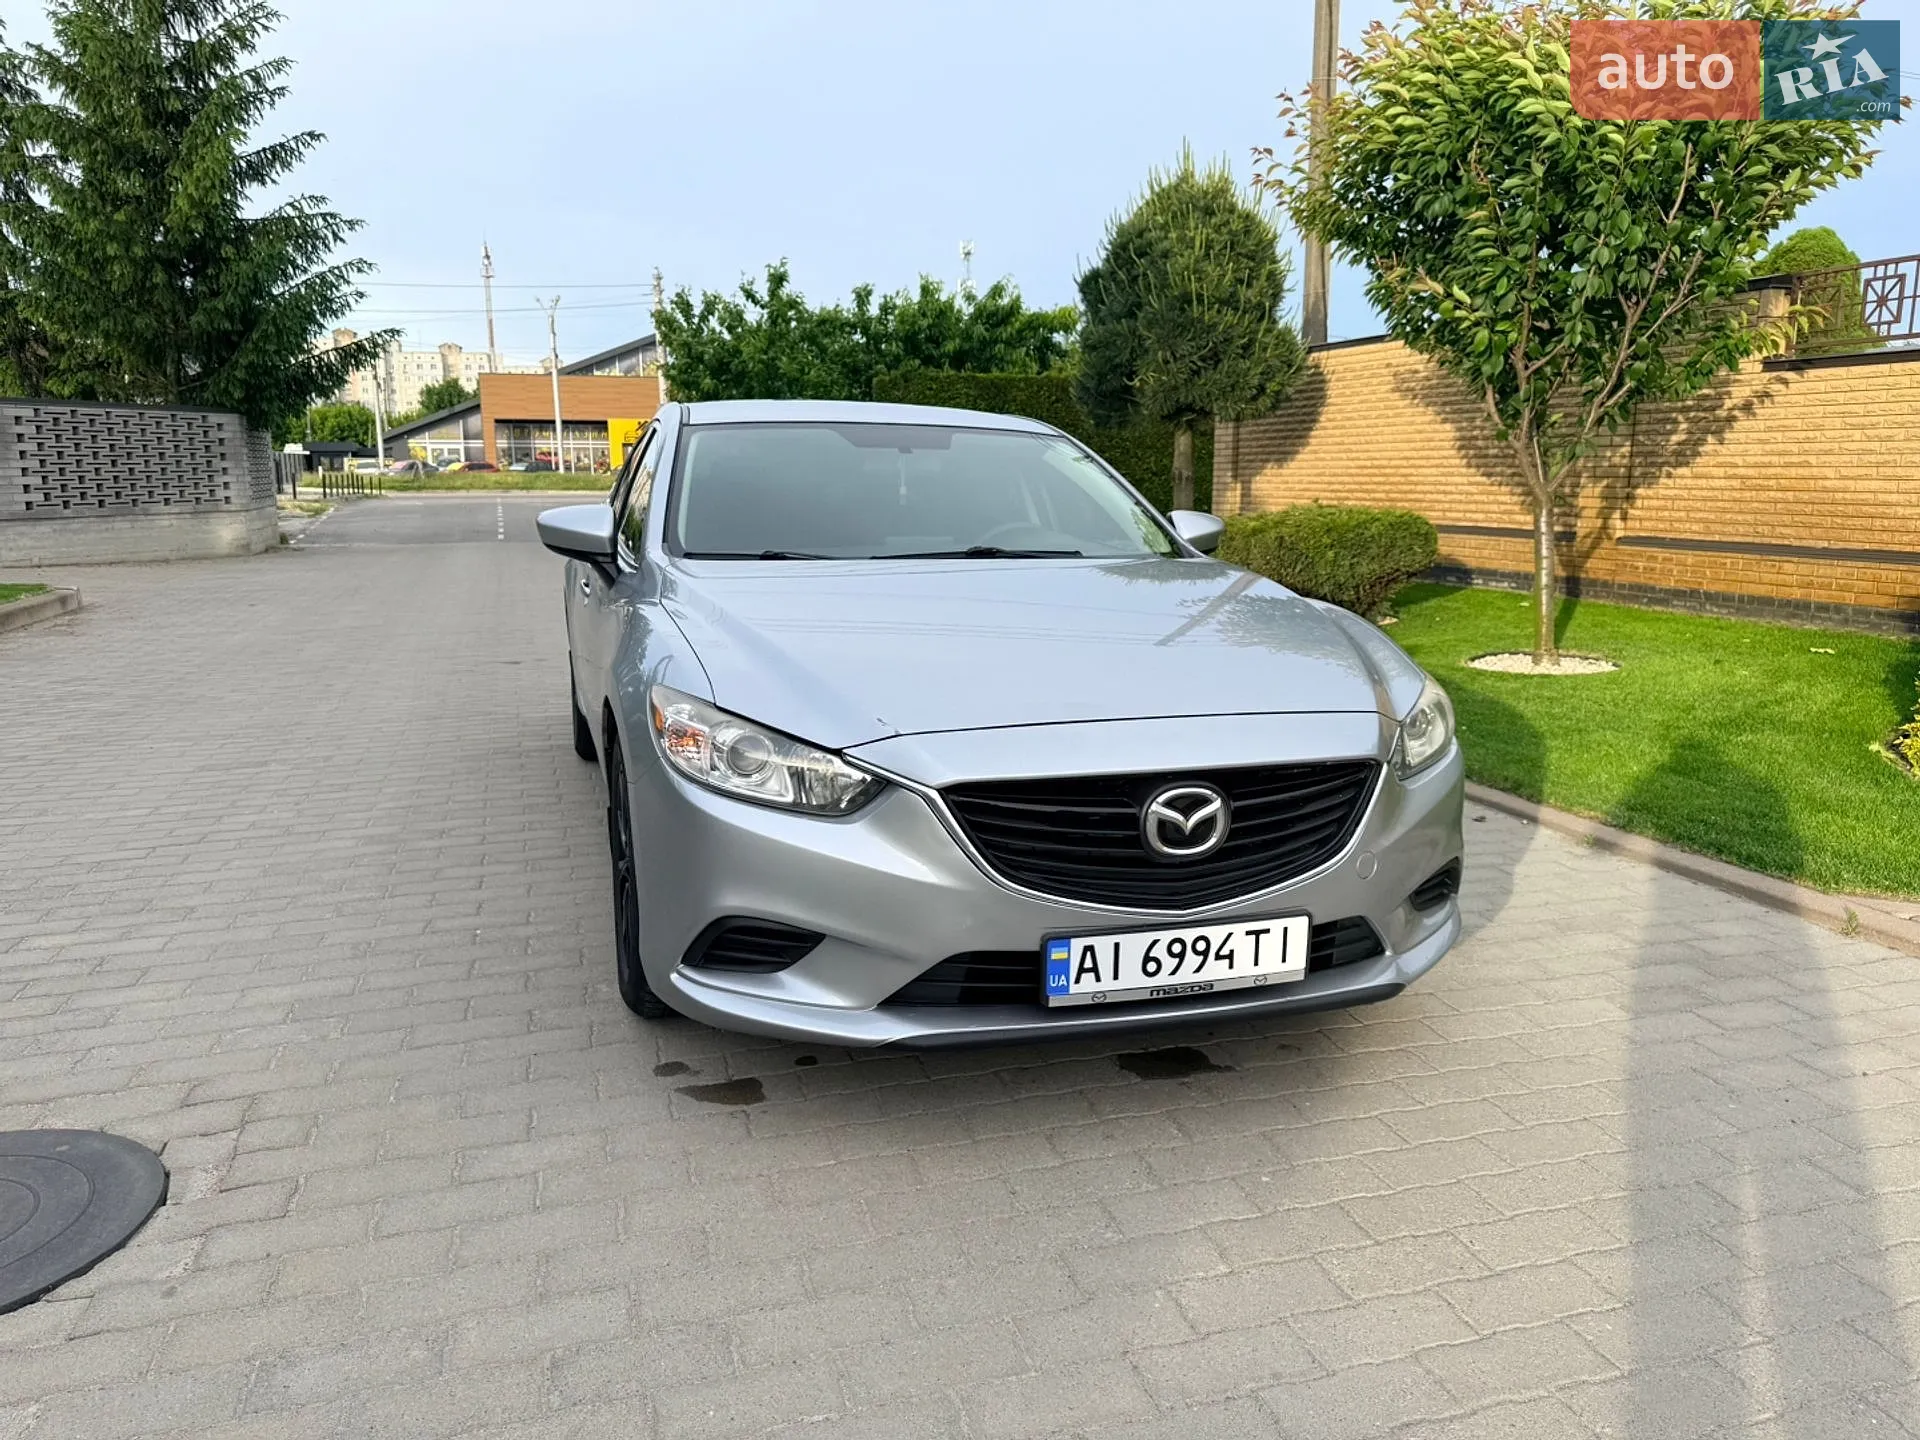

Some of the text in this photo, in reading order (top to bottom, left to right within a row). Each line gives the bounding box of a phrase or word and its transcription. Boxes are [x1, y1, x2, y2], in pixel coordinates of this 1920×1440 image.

[1073, 926, 1289, 985] AI 6994 TI
[1050, 974, 1068, 988] UA
